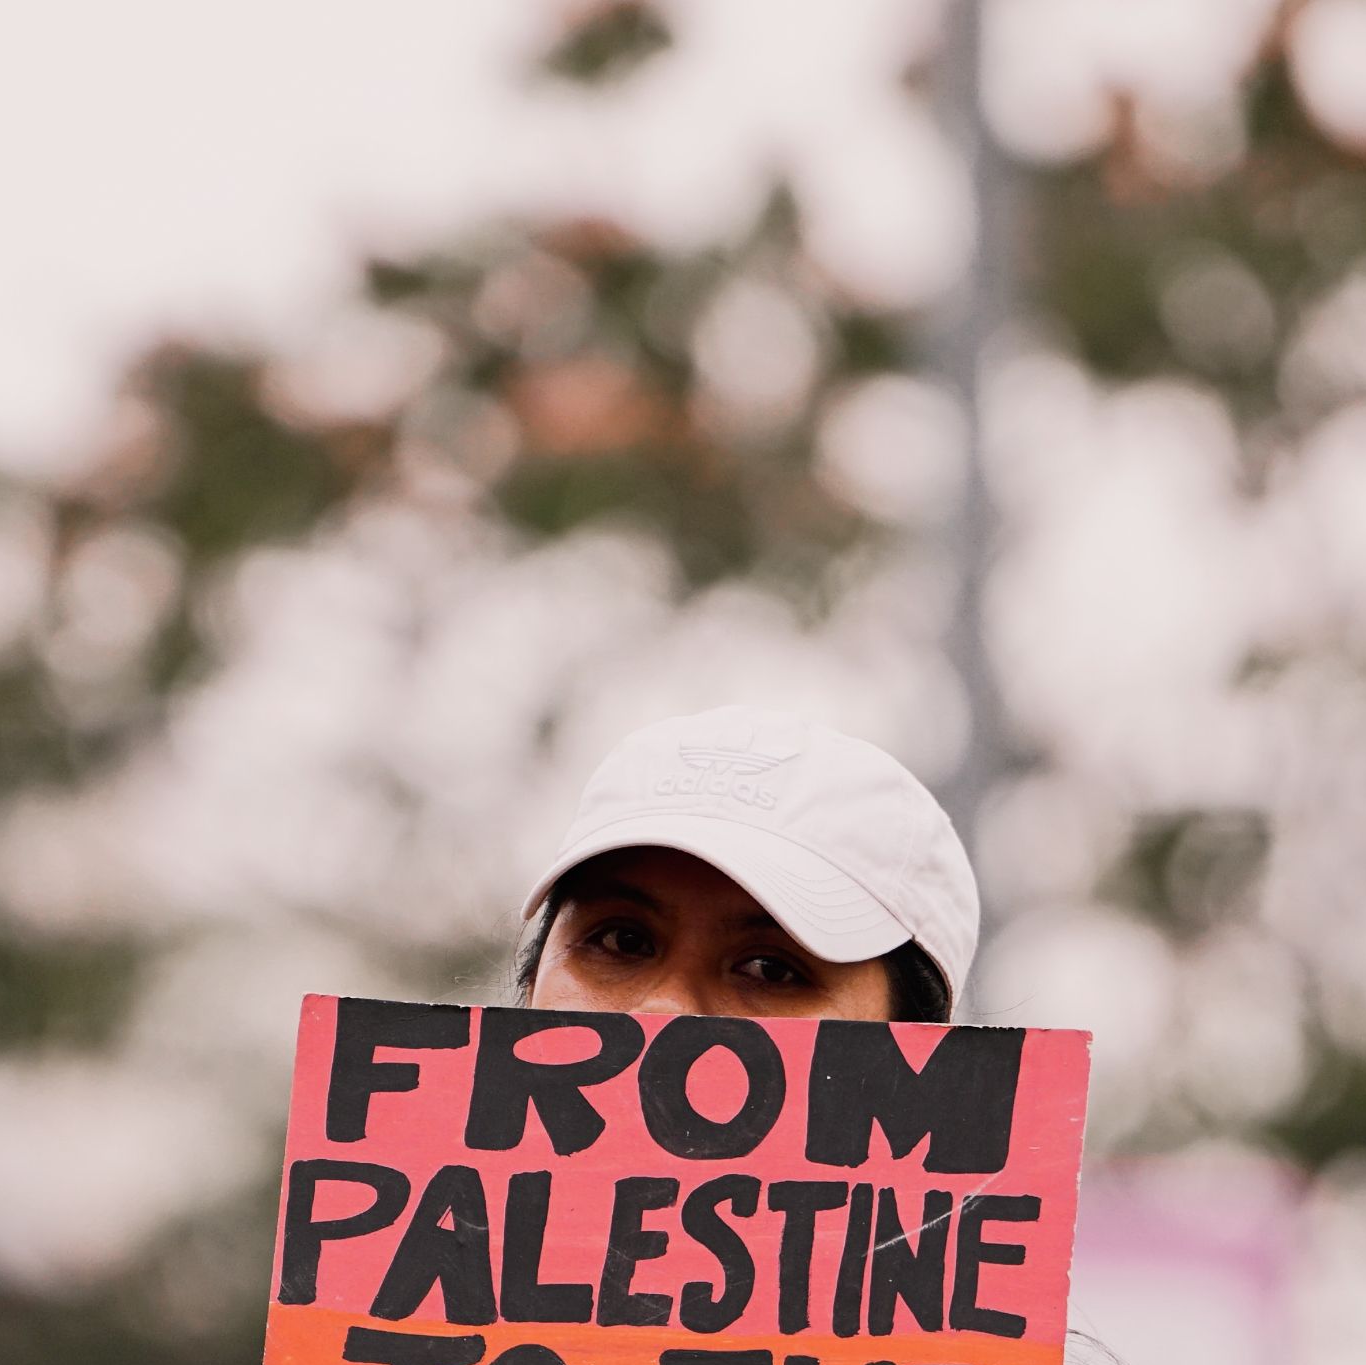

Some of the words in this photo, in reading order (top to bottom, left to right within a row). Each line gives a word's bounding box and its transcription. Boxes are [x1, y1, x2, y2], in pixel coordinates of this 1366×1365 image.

[654, 768, 777, 811] adidas
[326, 998, 1025, 1174] FROM
[278, 1159, 1041, 1339] PALESTINE
